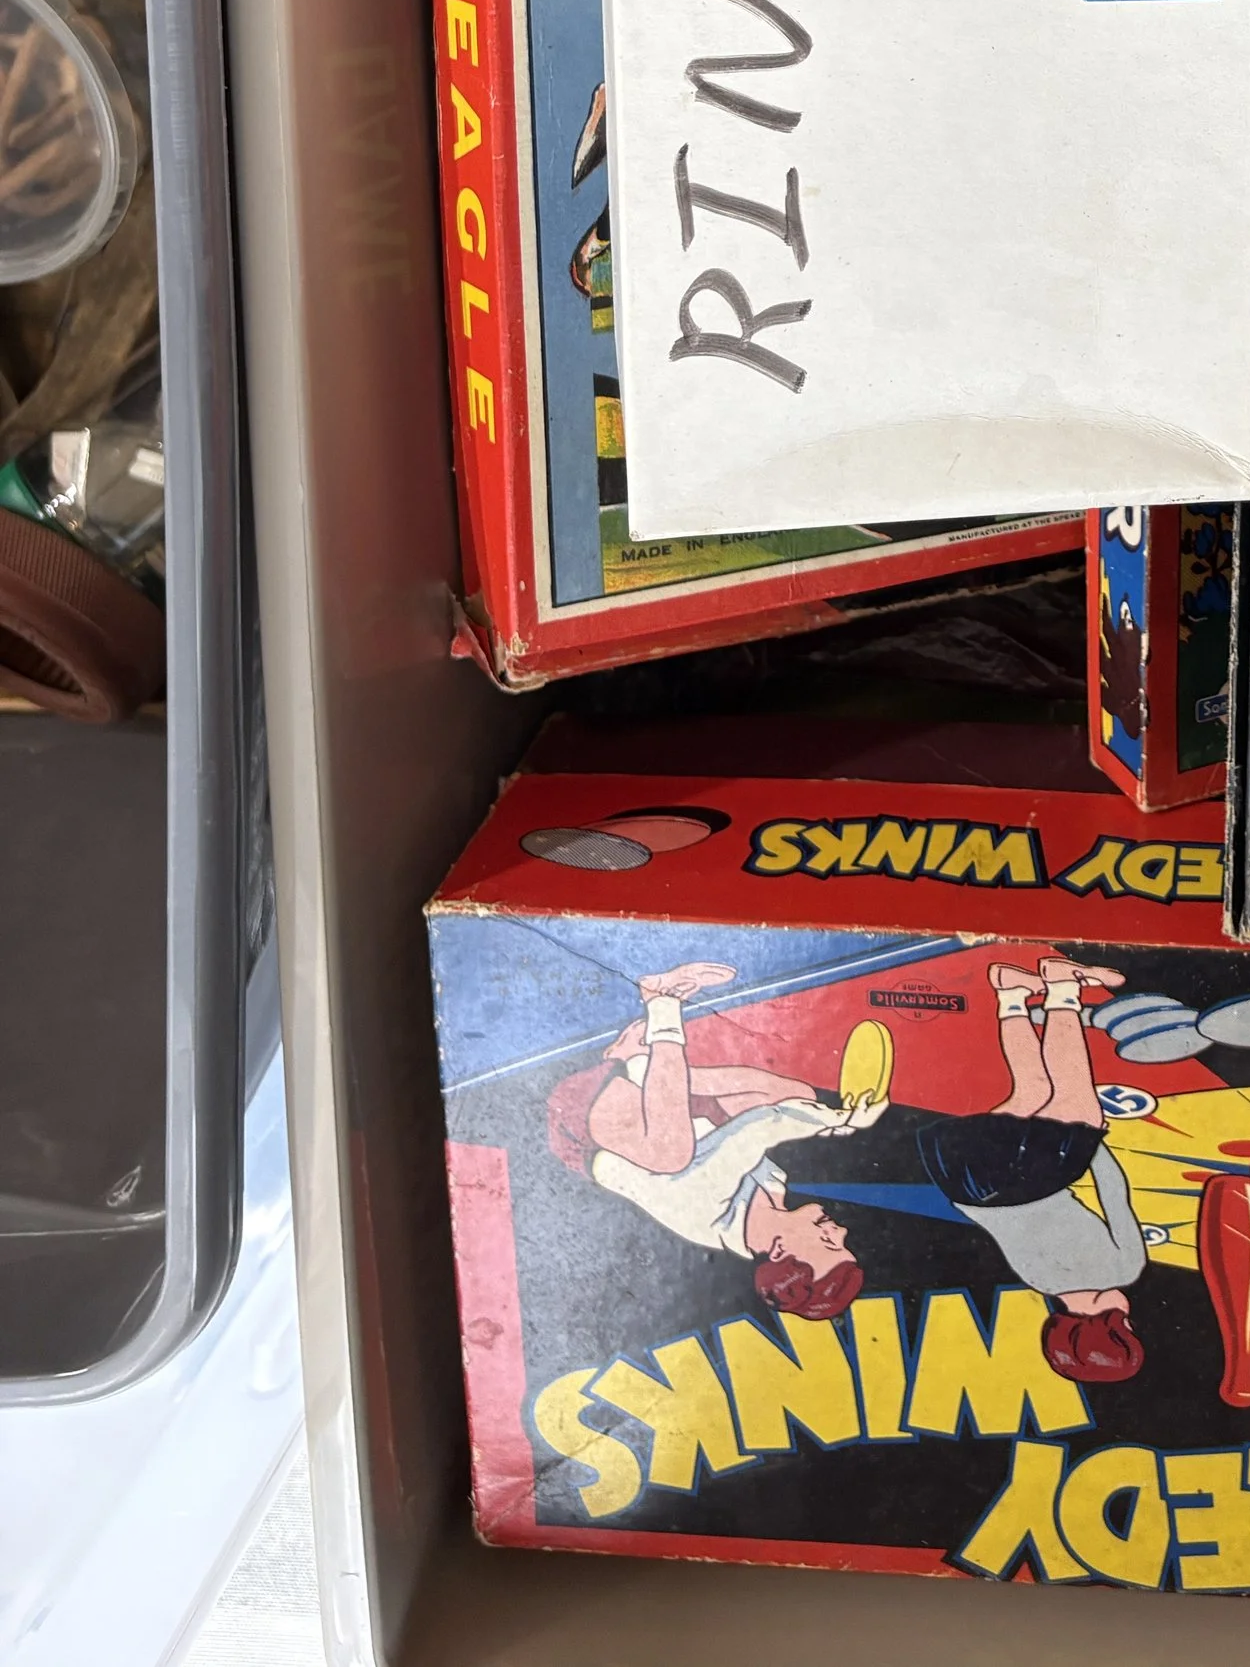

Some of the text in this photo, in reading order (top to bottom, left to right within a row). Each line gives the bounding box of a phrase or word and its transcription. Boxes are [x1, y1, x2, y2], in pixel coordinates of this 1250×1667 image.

[621, 544, 672, 562] MADE
[686, 538, 704, 551] IN
[755, 817, 1047, 886] WINKS
[876, 993, 958, 1011] Somerville
[534, 1286, 1097, 1523] WINKS
